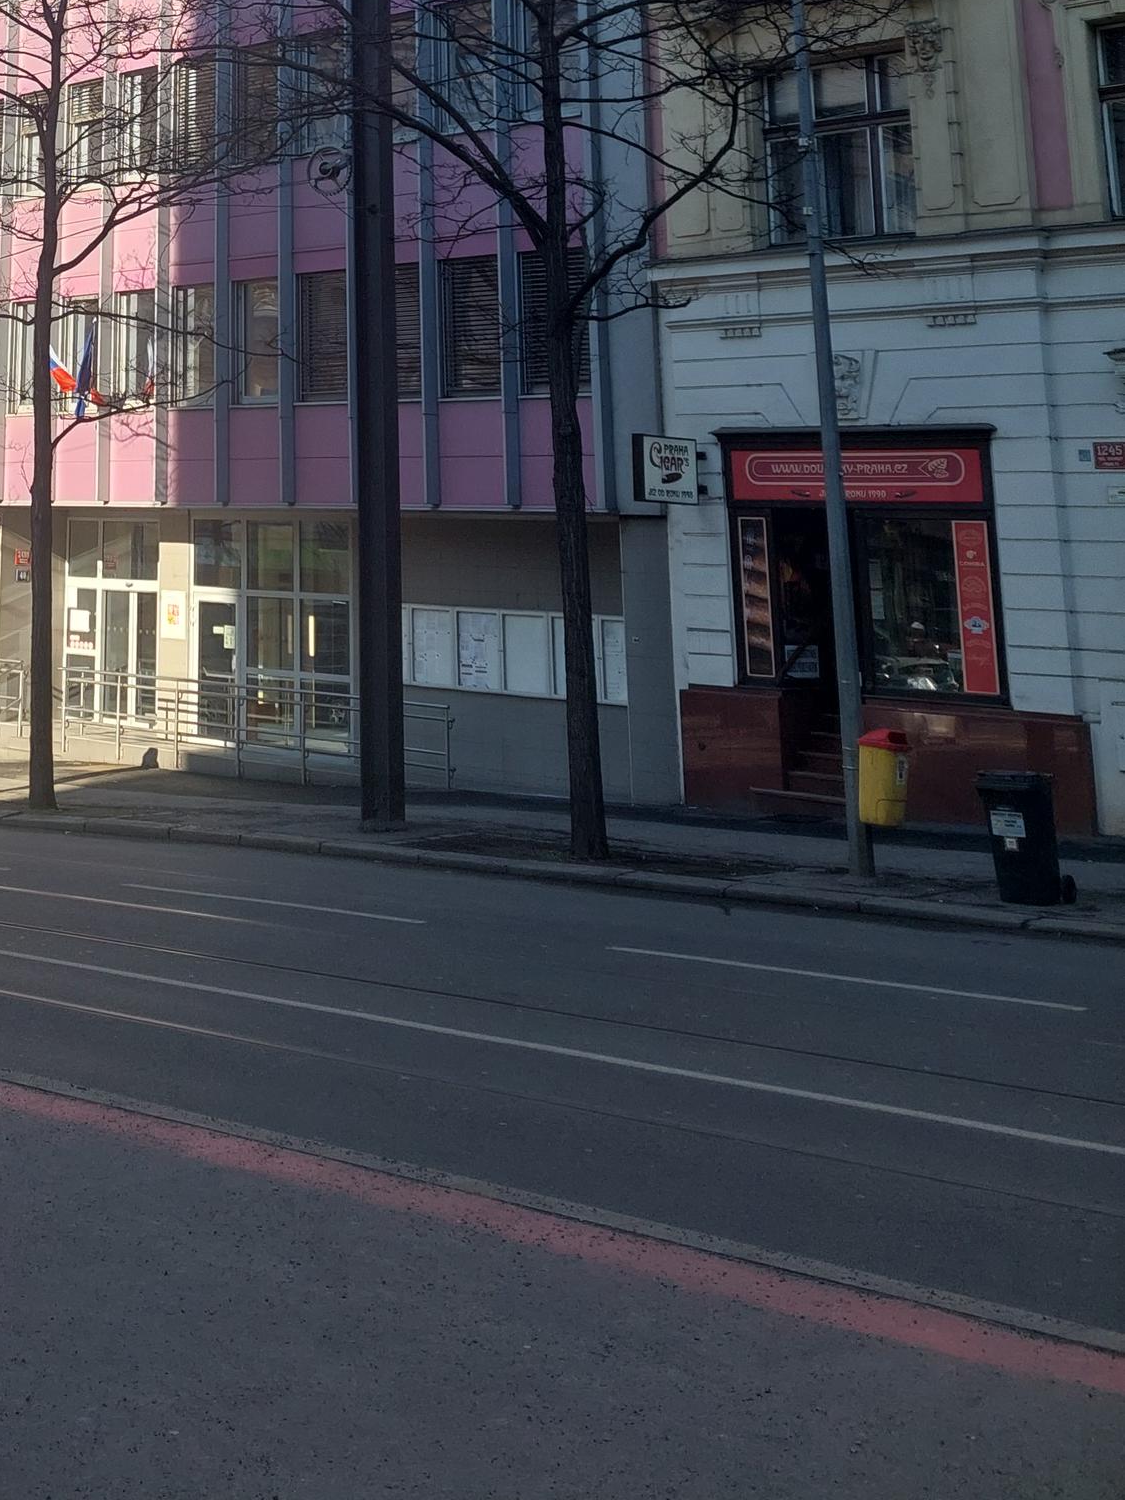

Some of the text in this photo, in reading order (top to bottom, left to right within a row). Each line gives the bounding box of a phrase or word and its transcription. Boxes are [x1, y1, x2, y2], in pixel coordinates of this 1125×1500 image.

[664, 444, 689, 456] PRAHA
[1097, 445, 1123, 456] 1245
[846, 490, 866, 498] ROKU
